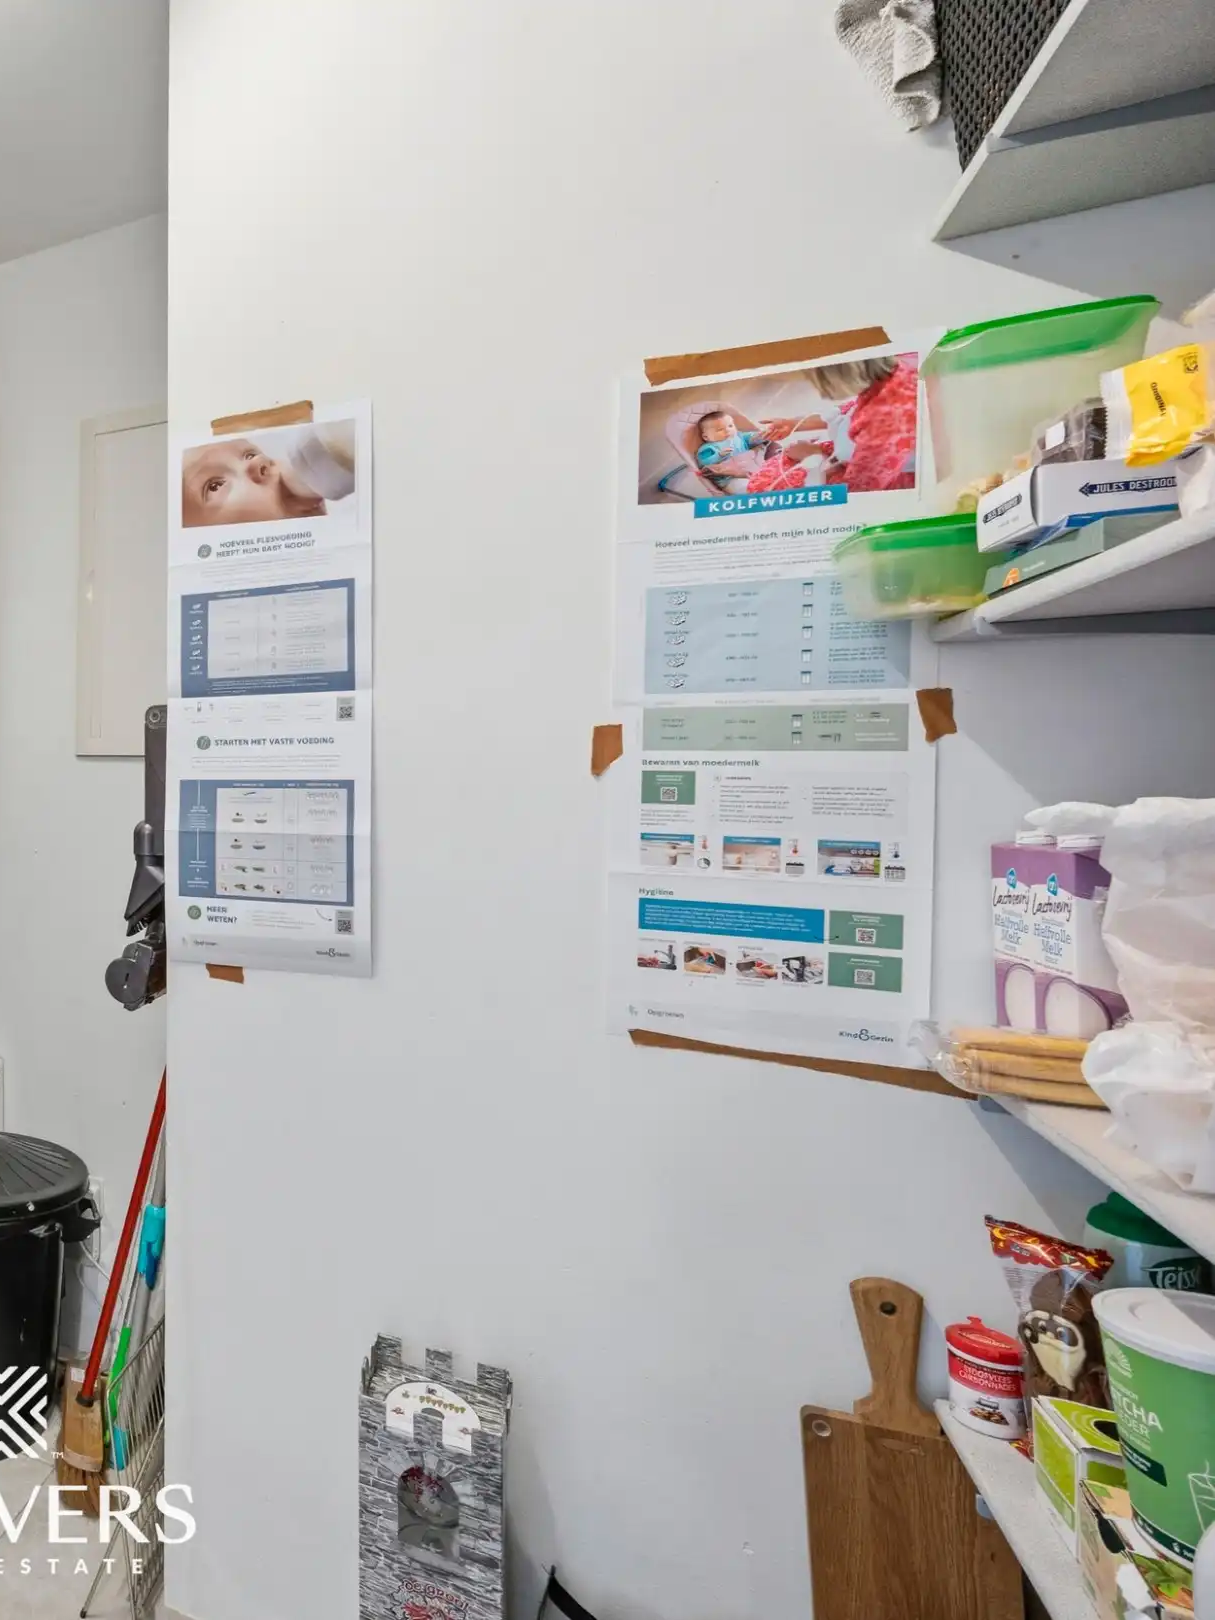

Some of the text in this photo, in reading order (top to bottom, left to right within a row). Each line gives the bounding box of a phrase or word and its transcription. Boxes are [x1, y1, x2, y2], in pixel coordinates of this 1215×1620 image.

[1093, 478, 1176, 493] JULES DESTROO
[708, 490, 833, 513] KOLFWIJZER
[654, 538, 690, 549] Hoeveel
[692, 533, 750, 546] moedermelk
[753, 531, 779, 540] heeft
[781, 528, 805, 539] mijn
[806, 525, 830, 536] kind
[214, 738, 249, 747] STARTEN
[269, 738, 295, 746] VASTE
[297, 737, 335, 745] VOEDING
[642, 758, 680, 767] Bewaren
[702, 758, 760, 767] moedermelk
[206, 905, 228, 914] MEER
[206, 915, 238, 924] WETEN?
[1111, 1386, 1164, 1433] TCHA
